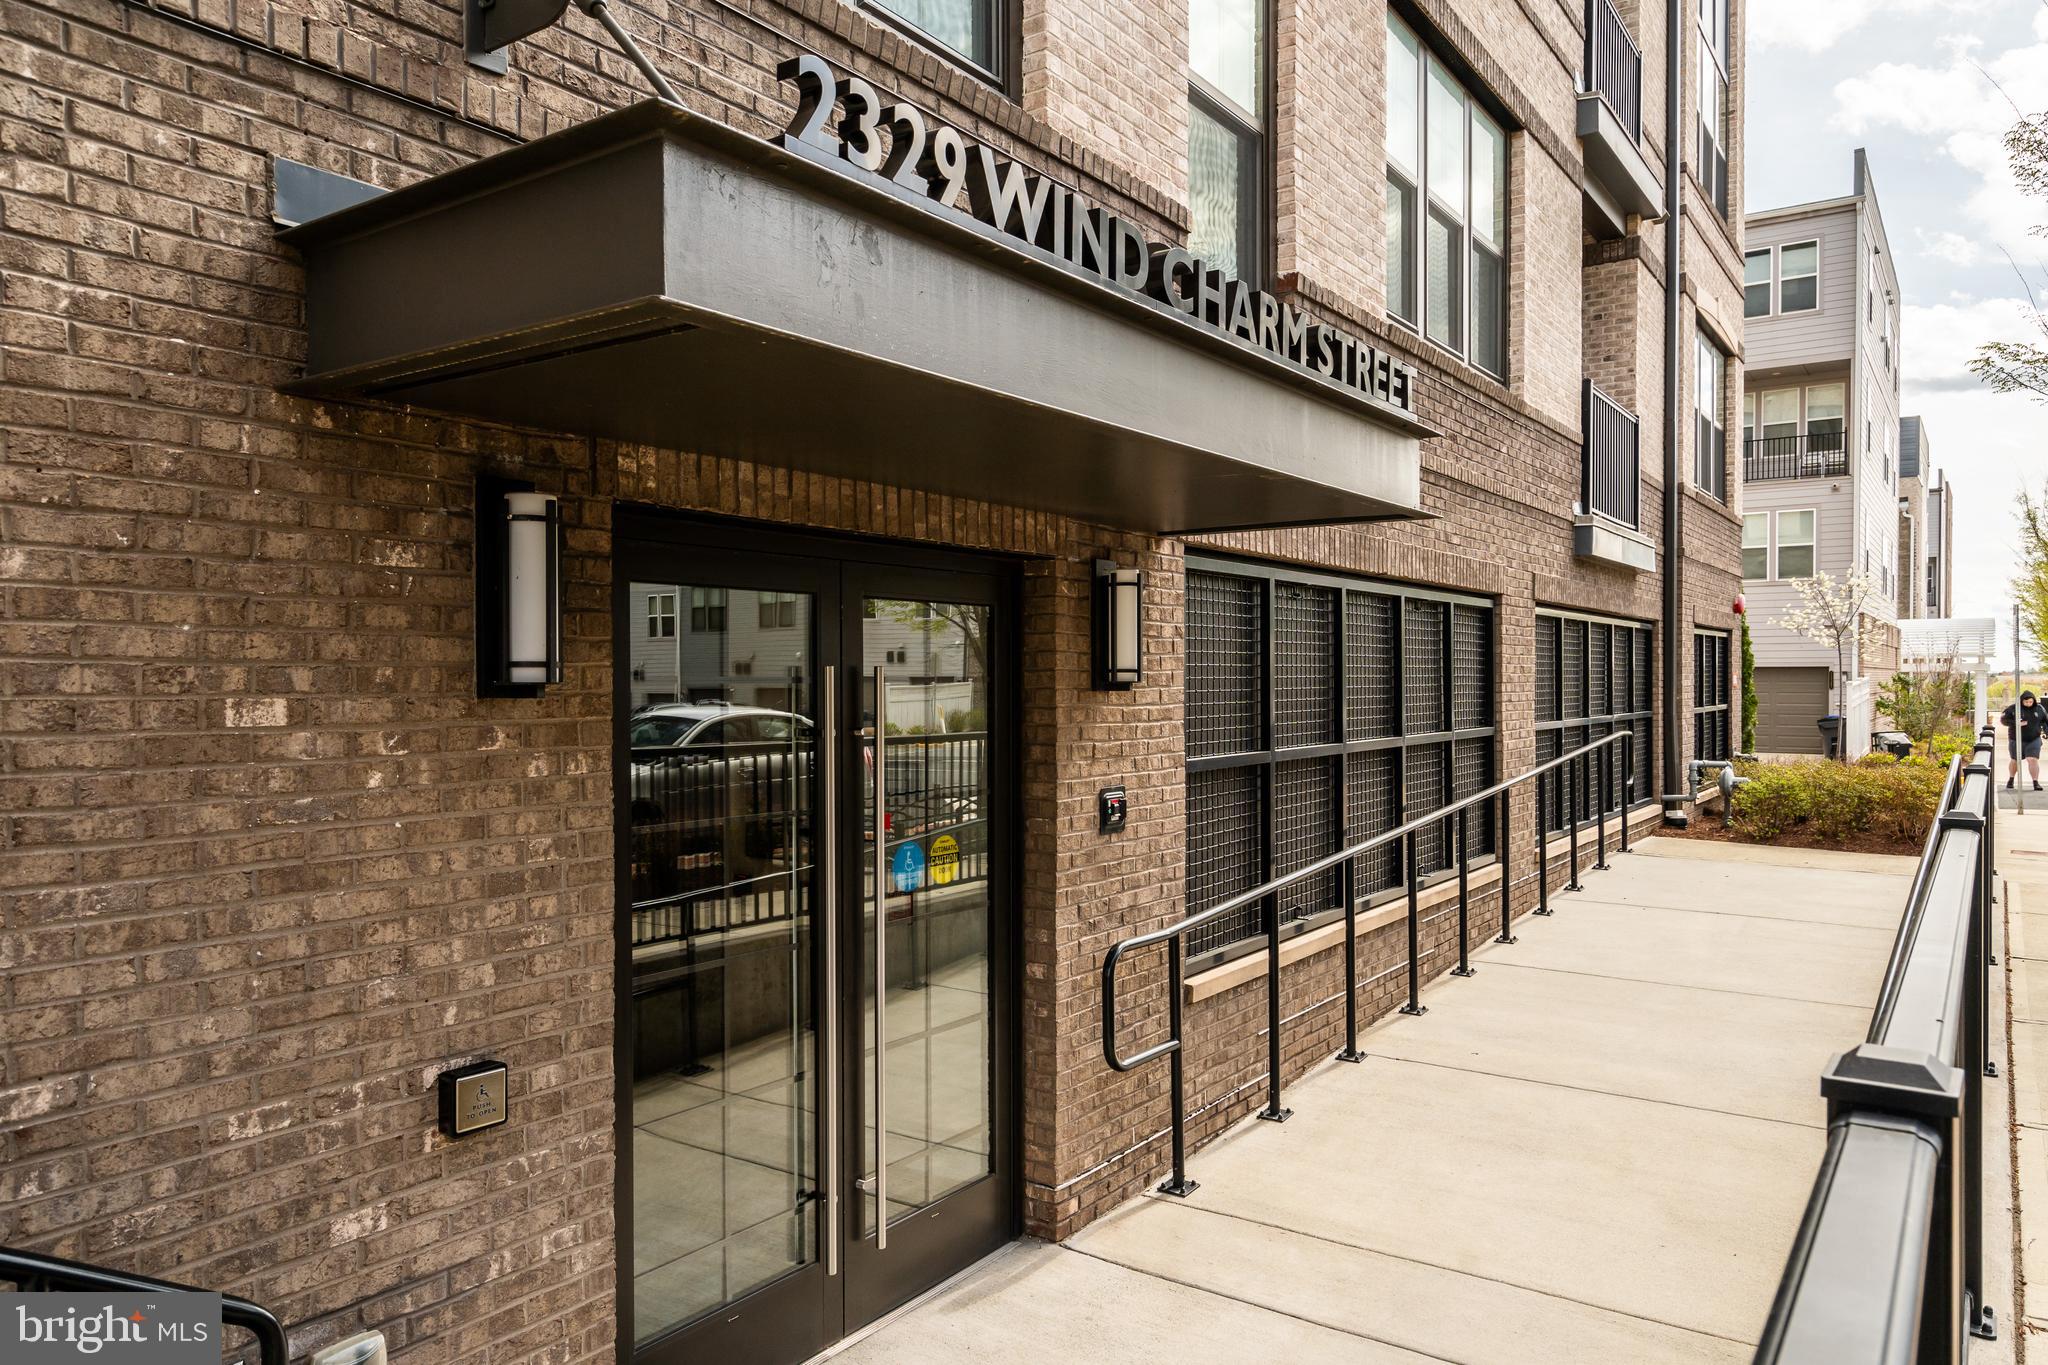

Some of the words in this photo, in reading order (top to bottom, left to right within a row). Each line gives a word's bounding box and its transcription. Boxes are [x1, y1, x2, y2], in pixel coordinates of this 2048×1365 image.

[782, 54, 968, 208] 2329
[974, 143, 1149, 292] WIND
[1160, 247, 1308, 369] CHARM
[1315, 323, 1418, 413] STREET
[931, 843, 958, 854] AUTOMATIC
[930, 854, 959, 866] CAUTION
[472, 1101, 491, 1111] PUSH
[478, 1107, 497, 1117] OPEN
